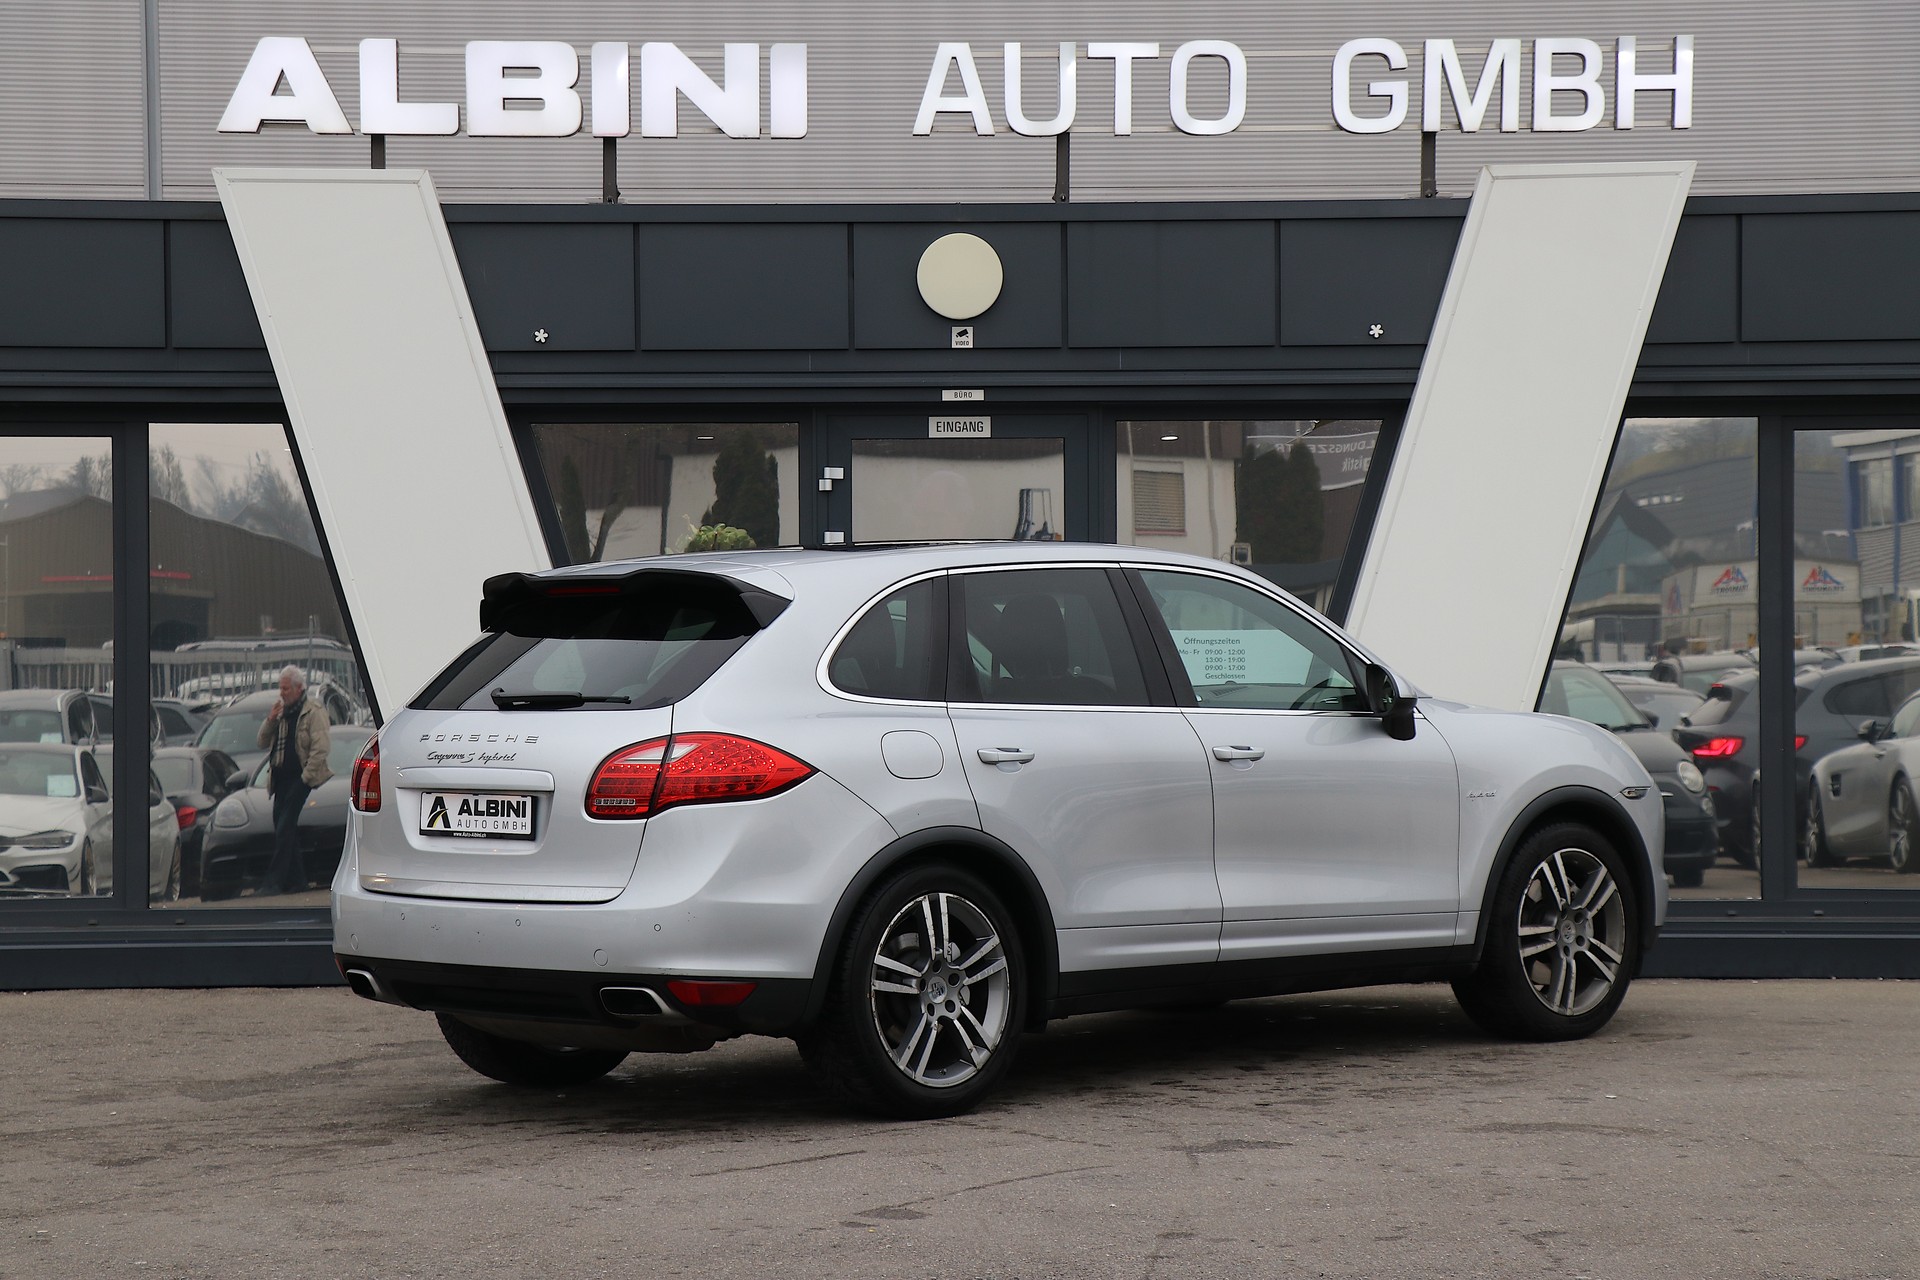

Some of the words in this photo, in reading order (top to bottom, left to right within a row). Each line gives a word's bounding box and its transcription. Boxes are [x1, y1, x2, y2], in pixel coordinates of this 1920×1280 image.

[216, 36, 808, 139] ALBINI
[912, 39, 1247, 137] AUTO
[1331, 34, 1694, 133] GMBH
[954, 391, 973, 399] BÜRO
[936, 421, 984, 433] EINGANG
[1183, 637, 1241, 646] Öffnungszeiten
[419, 734, 539, 744] PORSCHE
[457, 798, 527, 819] ALBINI
[456, 819, 488, 829] AUTO
[493, 820, 527, 831] GMBH
